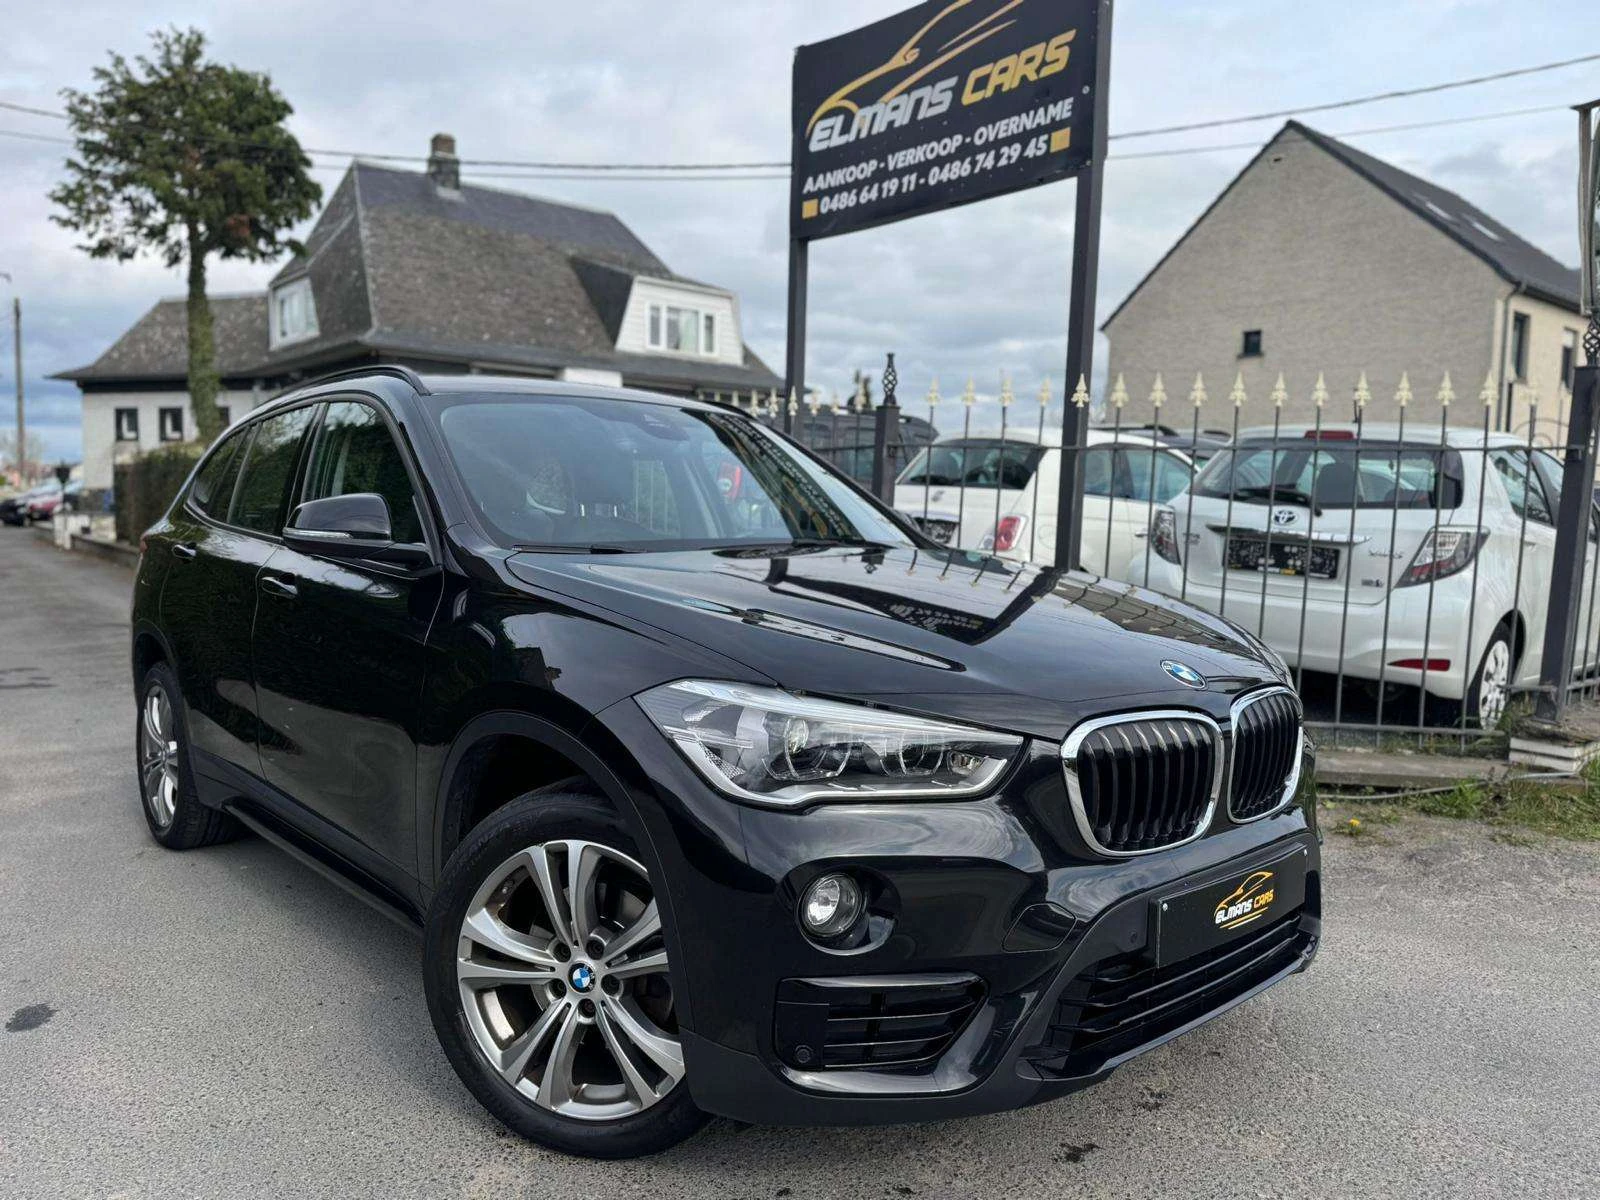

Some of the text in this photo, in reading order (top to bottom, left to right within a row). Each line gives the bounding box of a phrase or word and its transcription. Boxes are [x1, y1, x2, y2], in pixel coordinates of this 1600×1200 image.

[808, 29, 1077, 152] ELMANS CARS
[803, 158, 878, 193] AANKOOP
[887, 134, 963, 172] VERKOOP
[973, 97, 1074, 146] OVERNAME
[820, 189, 857, 214] 0486
[859, 183, 879, 202] 64
[882, 179, 899, 196] 19
[901, 173, 918, 192] 11
[928, 161, 972, 186] 0486
[974, 153, 995, 174] 74
[998, 145, 1021, 167] 29
[1024, 134, 1048, 159] 45
[1215, 889, 1274, 924] ELMANS CARS
